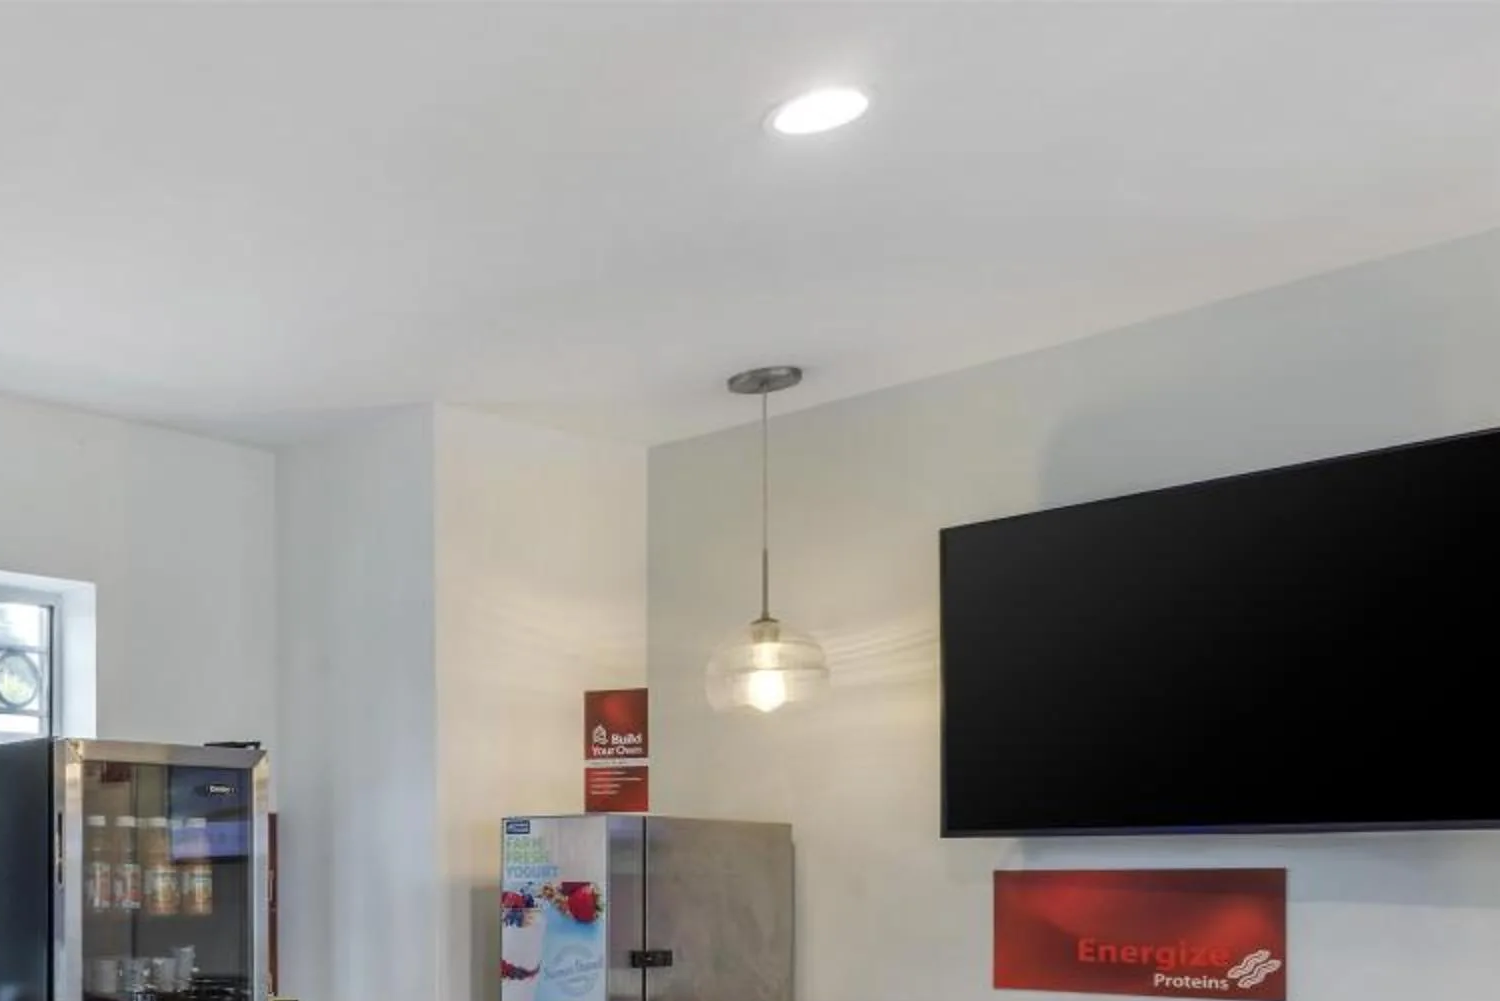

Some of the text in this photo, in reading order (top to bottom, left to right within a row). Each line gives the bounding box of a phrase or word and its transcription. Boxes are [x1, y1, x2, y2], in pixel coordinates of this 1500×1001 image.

[611, 732, 643, 745] Build
[506, 865, 559, 879] YOGURT
[1076, 937, 1230, 971] Energize
[1153, 972, 1230, 991] Proteins
